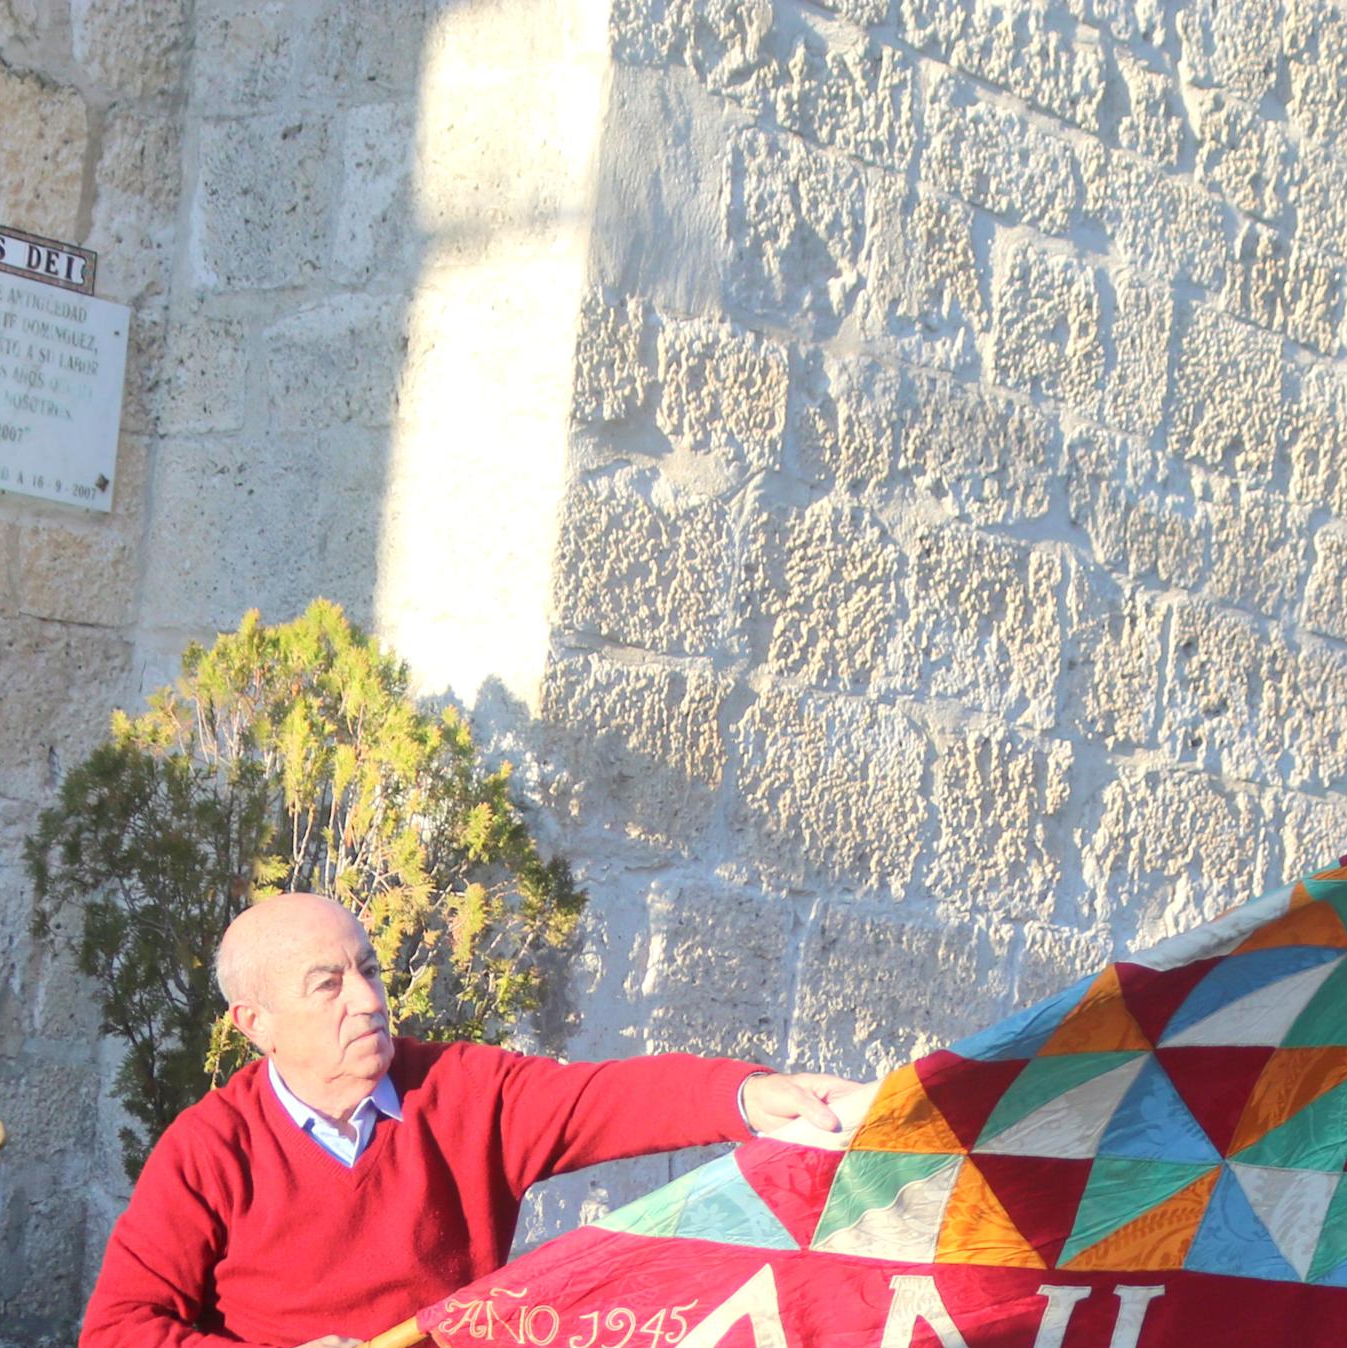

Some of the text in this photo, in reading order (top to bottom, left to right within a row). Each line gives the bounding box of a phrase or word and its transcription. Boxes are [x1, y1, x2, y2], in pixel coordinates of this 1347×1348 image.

[26, 243, 76, 281] DEI
[16, 469, 24, 486] A
[72, 485, 98, 501] 2007
[438, 1288, 560, 1347] AÑO
